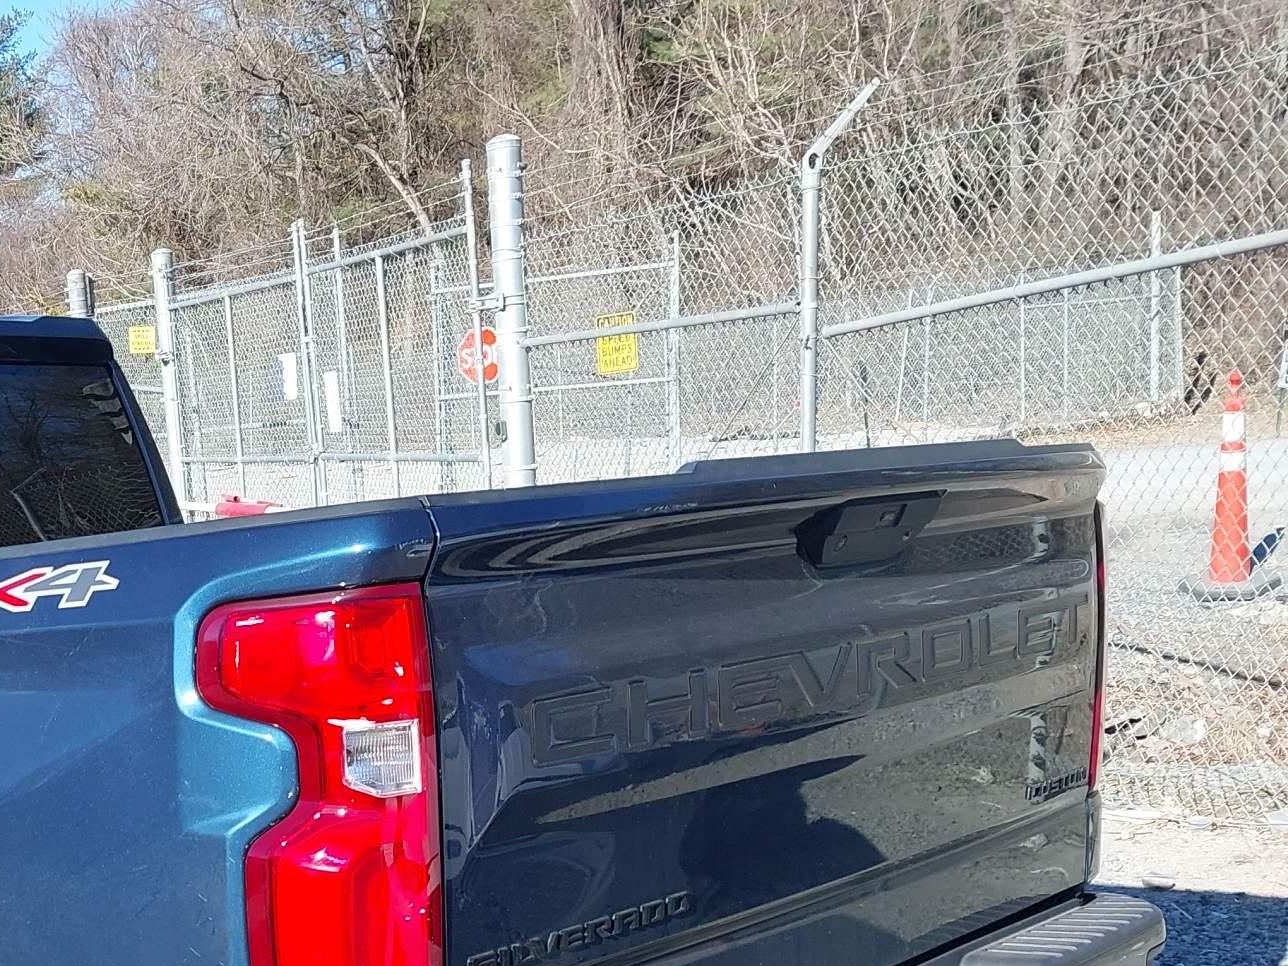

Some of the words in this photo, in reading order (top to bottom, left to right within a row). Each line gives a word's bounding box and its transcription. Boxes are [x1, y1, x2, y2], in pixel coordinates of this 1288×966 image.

[601, 343, 632, 357] BUMPS
[602, 355, 633, 369] AHEAD
[531, 600, 1090, 765] CHEVROLET
